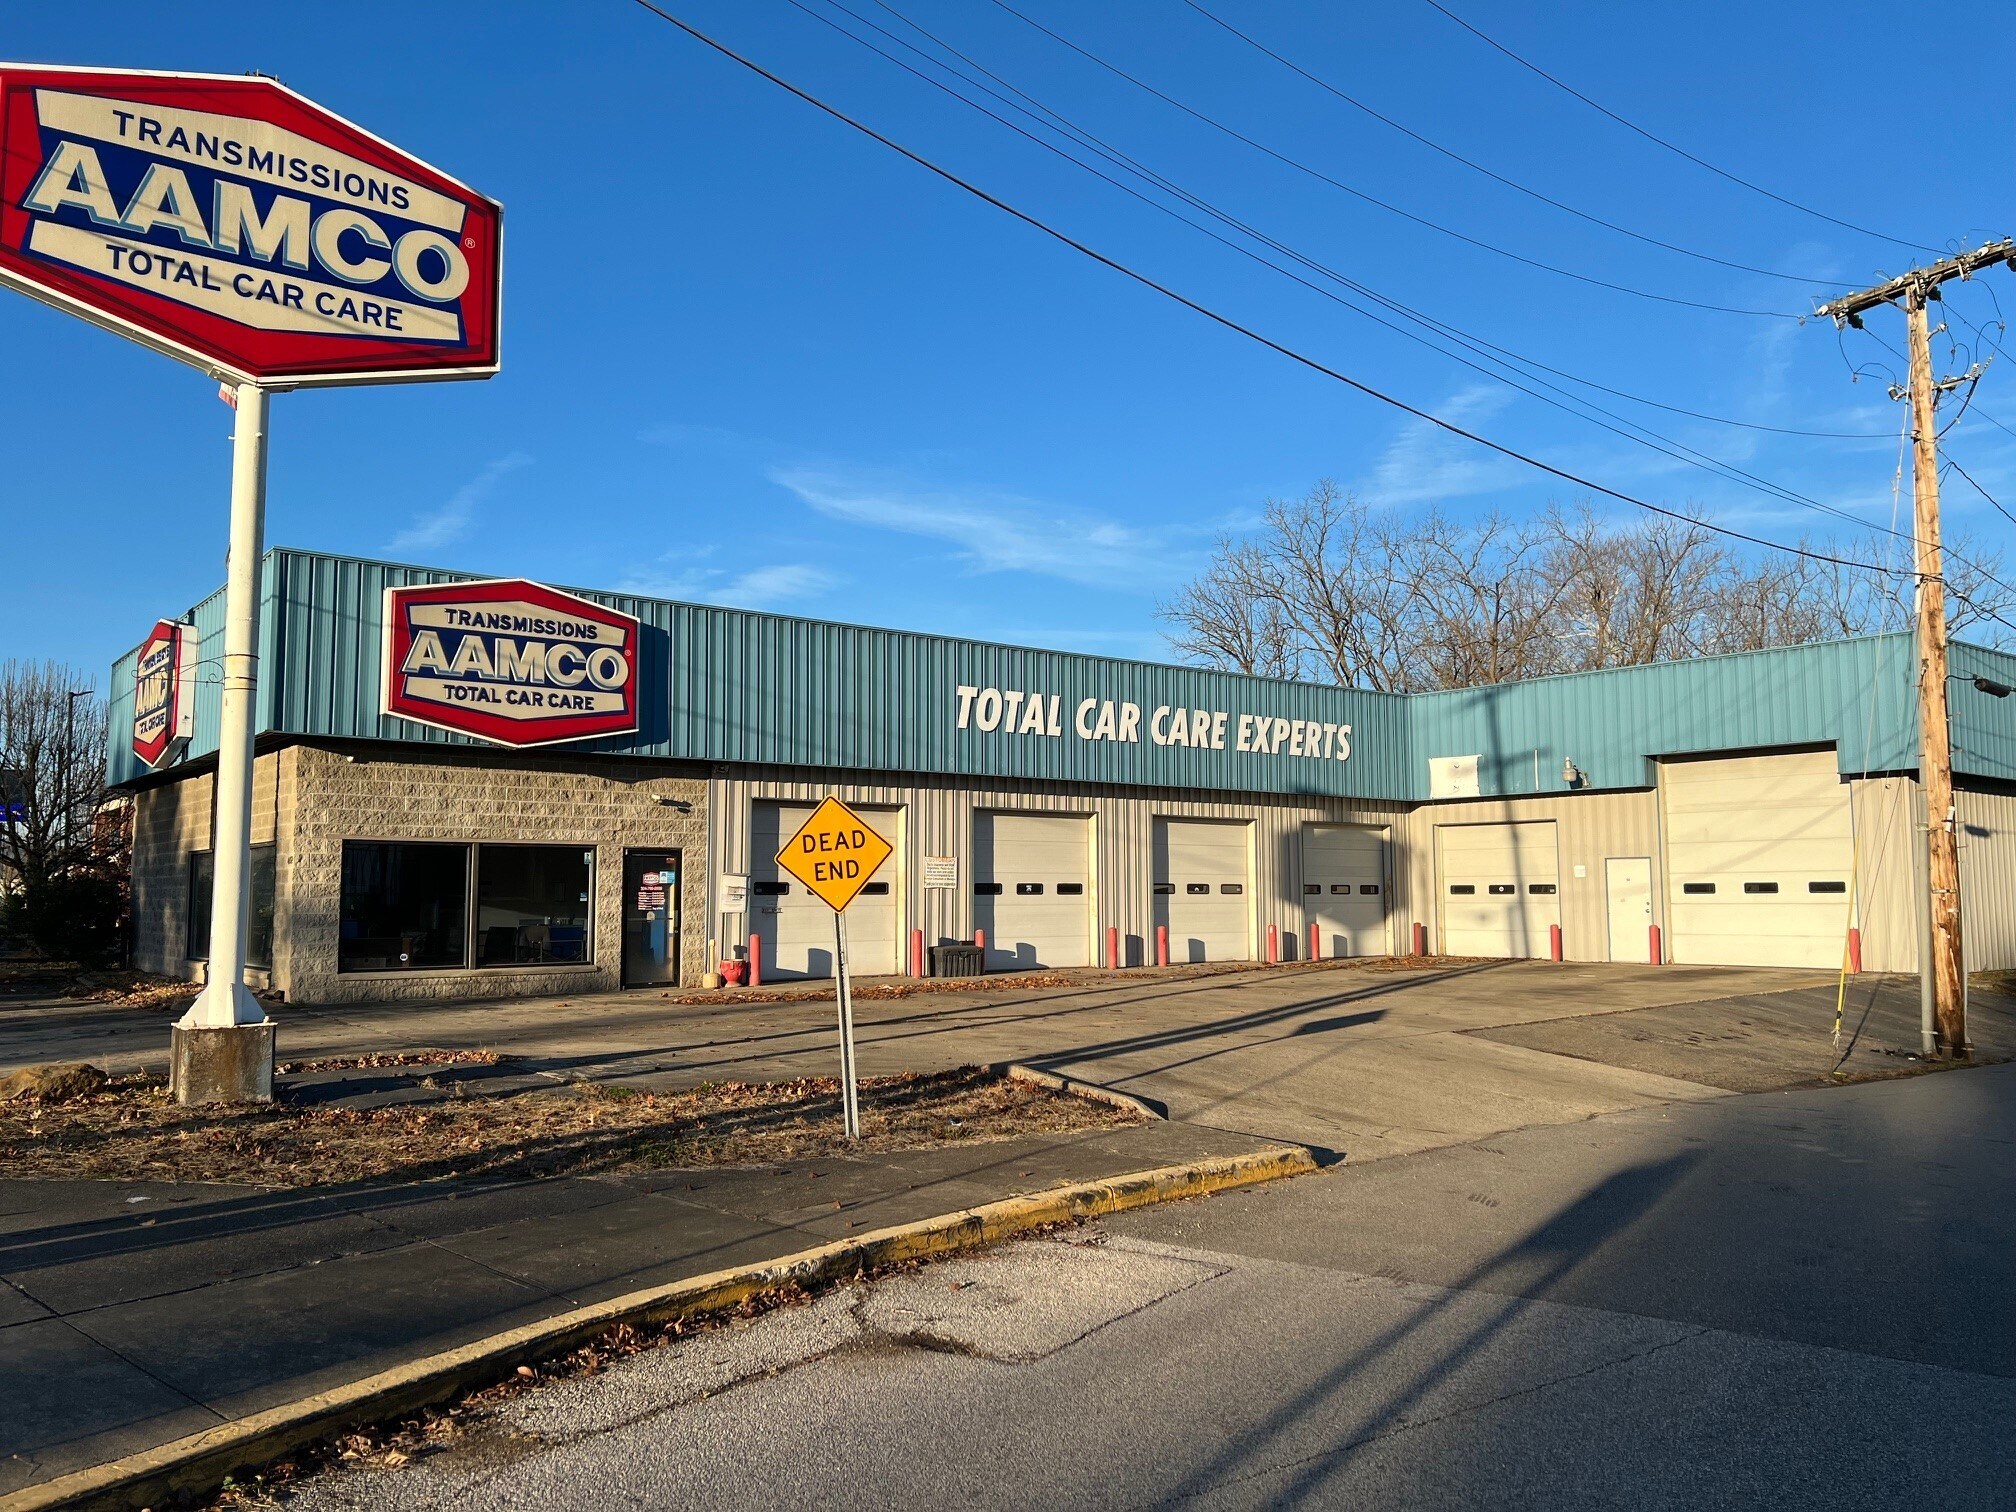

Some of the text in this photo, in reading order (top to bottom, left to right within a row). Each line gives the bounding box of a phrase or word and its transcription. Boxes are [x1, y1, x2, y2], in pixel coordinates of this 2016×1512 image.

[113, 110, 409, 210] TRANSMISSIONS
[22, 140, 470, 302] AAMCO
[106, 244, 403, 331] TOTAL CAR CARE
[444, 608, 597, 639] TRANSMISSIONS
[402, 630, 628, 690] AAMCO
[442, 684, 595, 710] TOTAL CAR CARE
[957, 685, 1352, 761] TOTAL CAR CARE EXPERTS
[802, 829, 866, 854] DEAD
[814, 859, 860, 882] END
